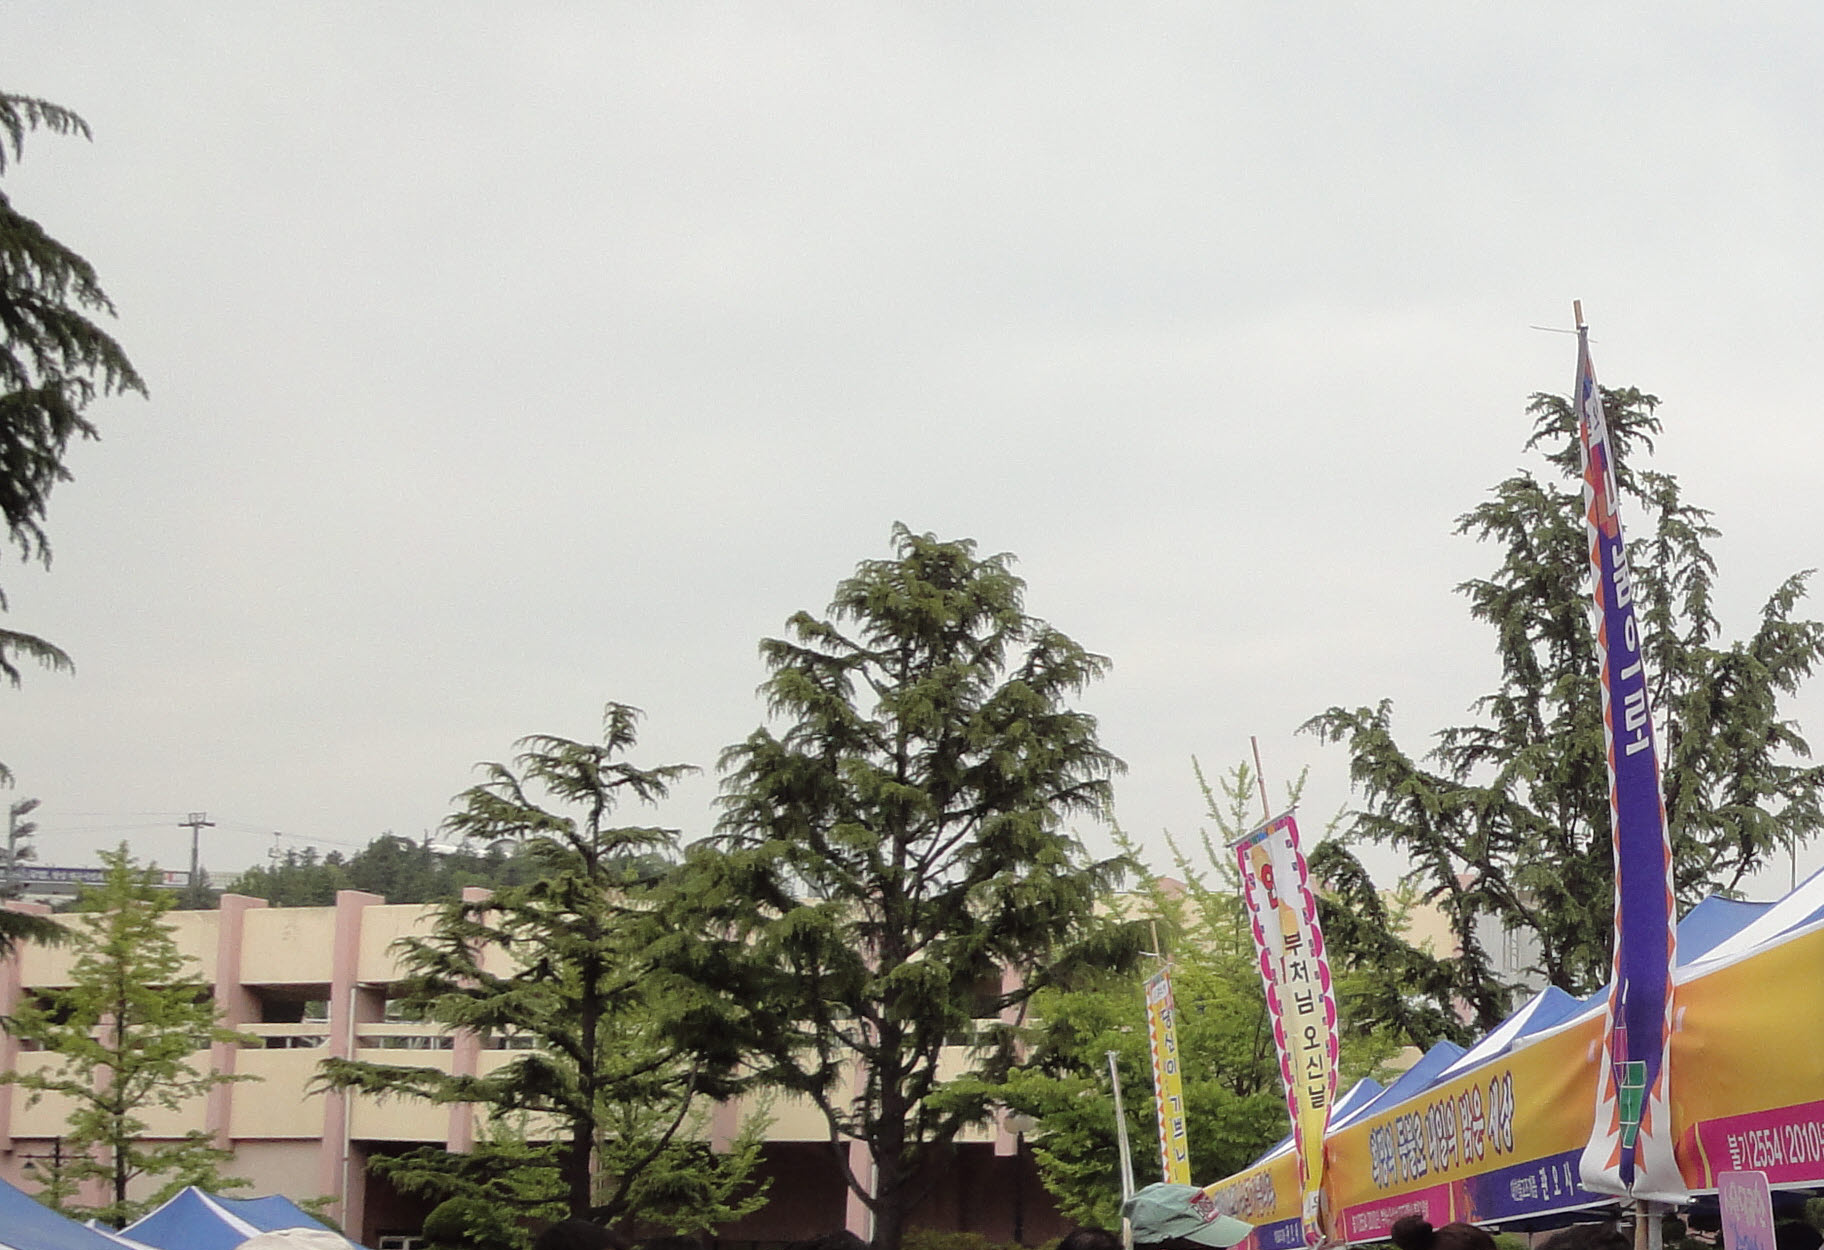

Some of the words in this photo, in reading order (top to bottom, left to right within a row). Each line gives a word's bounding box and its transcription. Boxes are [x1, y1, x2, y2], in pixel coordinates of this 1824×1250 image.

[1283, 932, 1315, 1016] 부처님
[1303, 1024, 1326, 1110] 오신날
[1424, 1094, 1460, 1173] 내일의
[1458, 1083, 1486, 1165] 밝은
[1487, 1070, 1515, 1155] 세상
